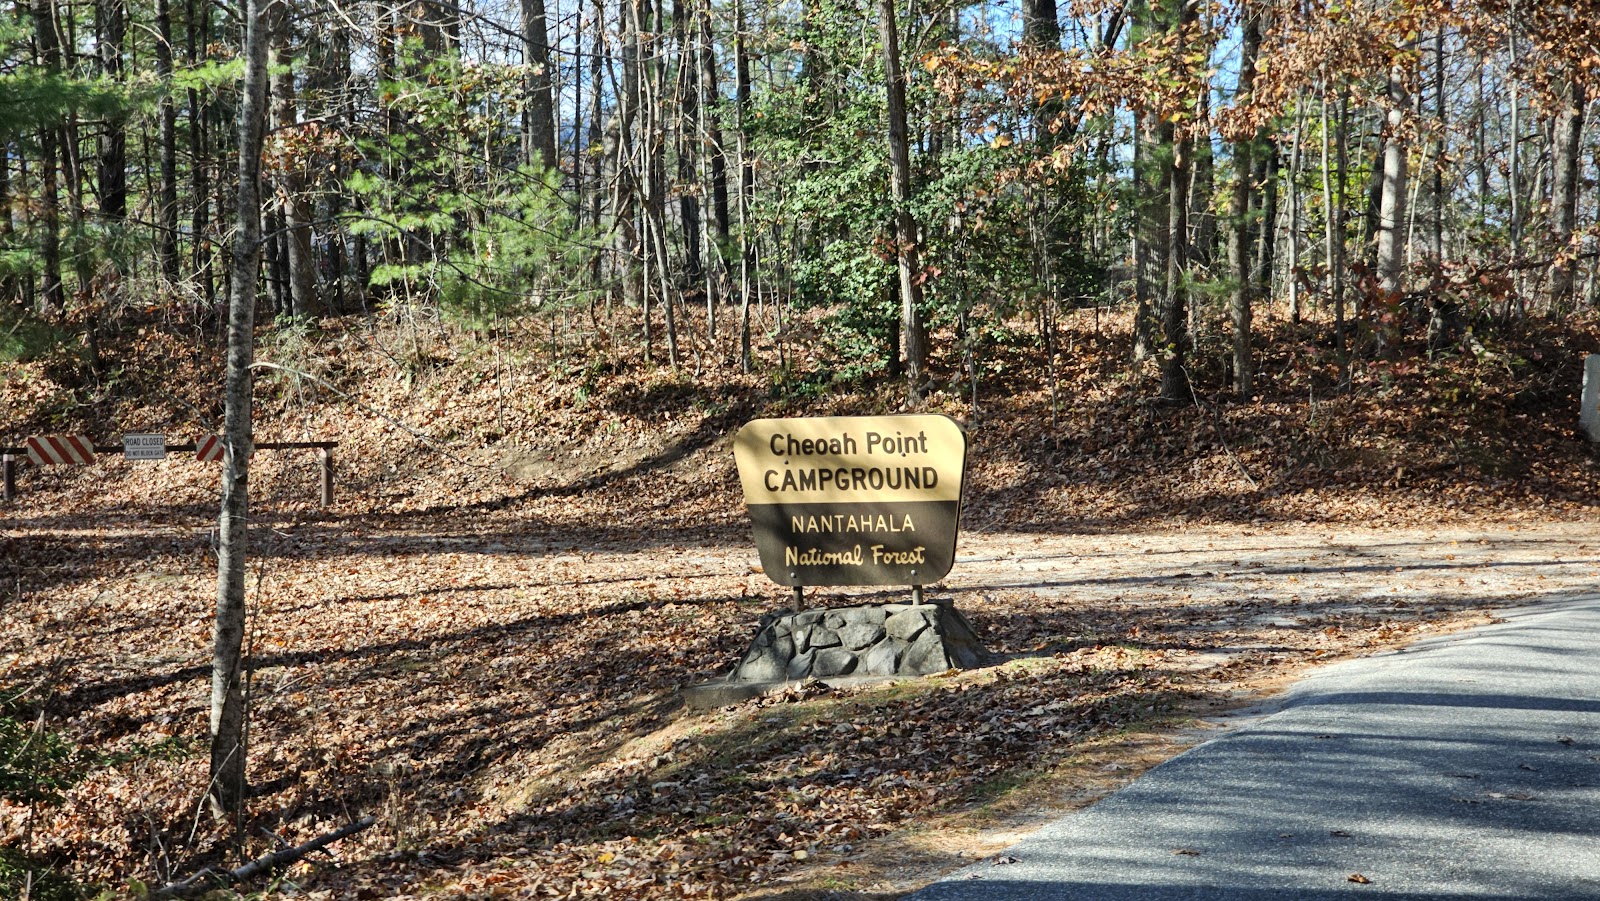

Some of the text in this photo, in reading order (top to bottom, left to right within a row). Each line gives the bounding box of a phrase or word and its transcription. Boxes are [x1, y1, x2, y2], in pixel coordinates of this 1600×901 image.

[126, 437, 164, 446] ROAD CLOSED
[770, 431, 928, 456] Cheoah Point
[764, 466, 938, 492] CAMPGROUND
[791, 513, 916, 534] NANTAHALA
[785, 544, 926, 567] National Forest
